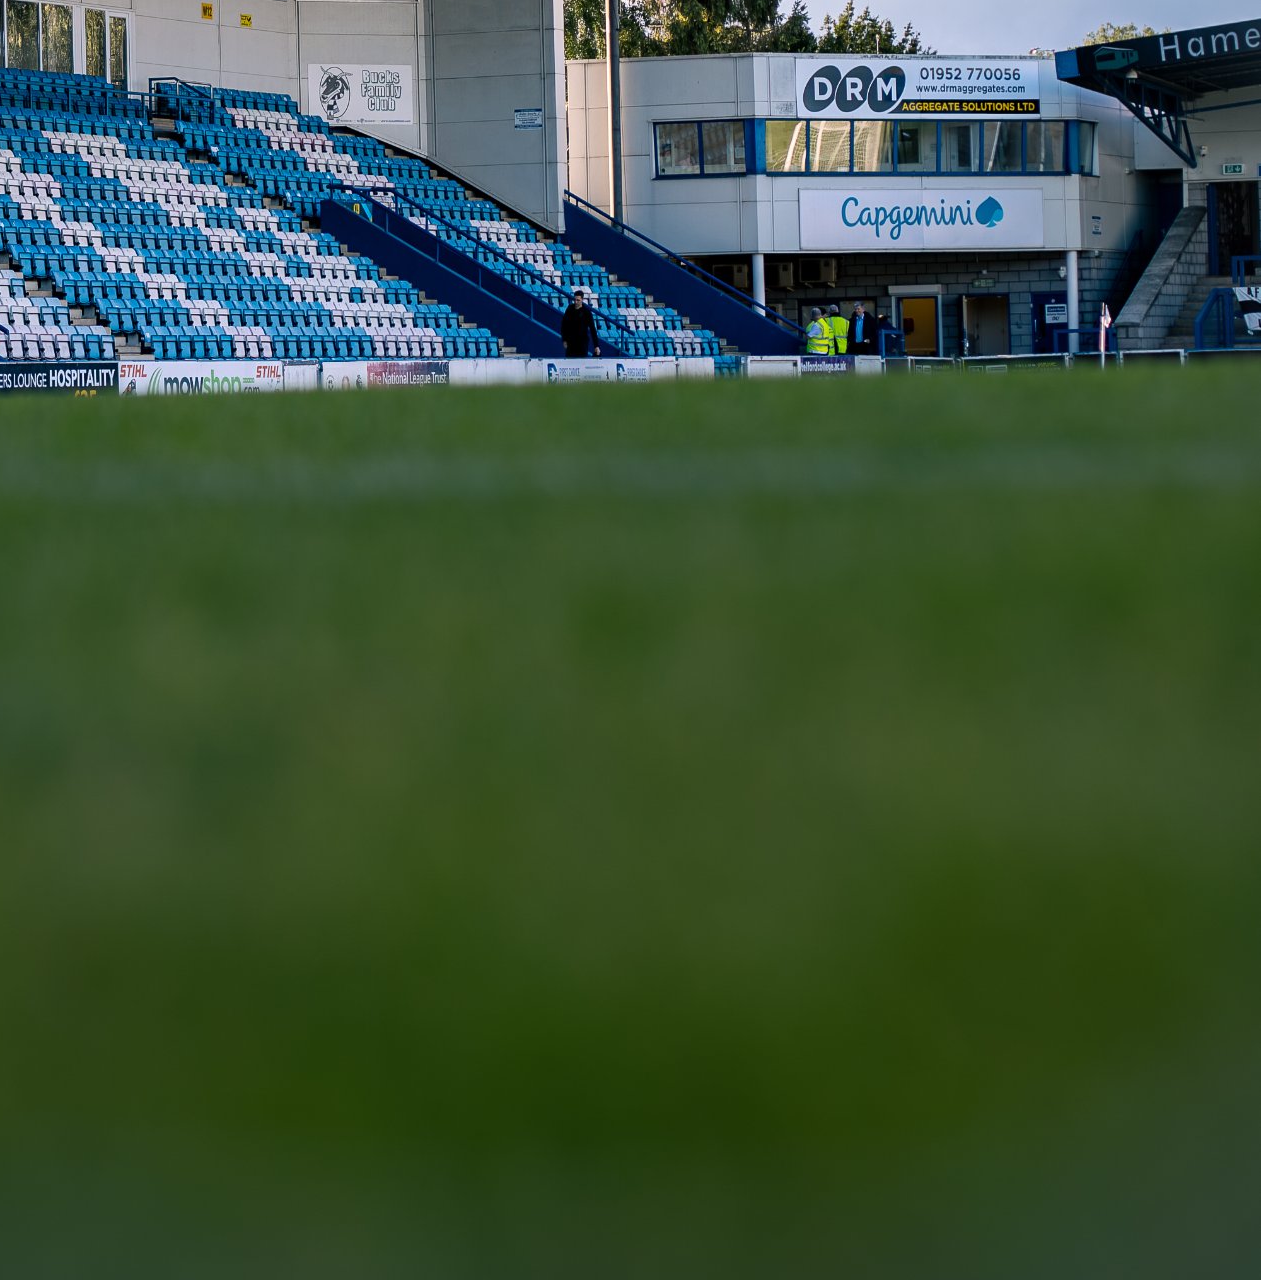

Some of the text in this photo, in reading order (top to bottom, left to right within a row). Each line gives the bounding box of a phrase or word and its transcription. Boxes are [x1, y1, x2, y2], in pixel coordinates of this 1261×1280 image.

[1159, 27, 1261, 62] Hame
[362, 70, 400, 84] Bucks
[920, 67, 1021, 81] 01952 770056
[361, 84, 402, 98] Family
[813, 77, 897, 101] DRM
[915, 84, 1026, 95] www.drmaggregates.com
[367, 97, 396, 112] Club
[902, 101, 1036, 112] AGGREGATE SOLUTIONS LTD
[841, 196, 974, 241] Capgemini
[120, 364, 147, 378] STIHL
[256, 365, 281, 378] STIHL
[13, 373, 47, 388] LOUNGE
[49, 369, 115, 388] HOSPITALITY
[370, 371, 447, 387] The National League Trust
